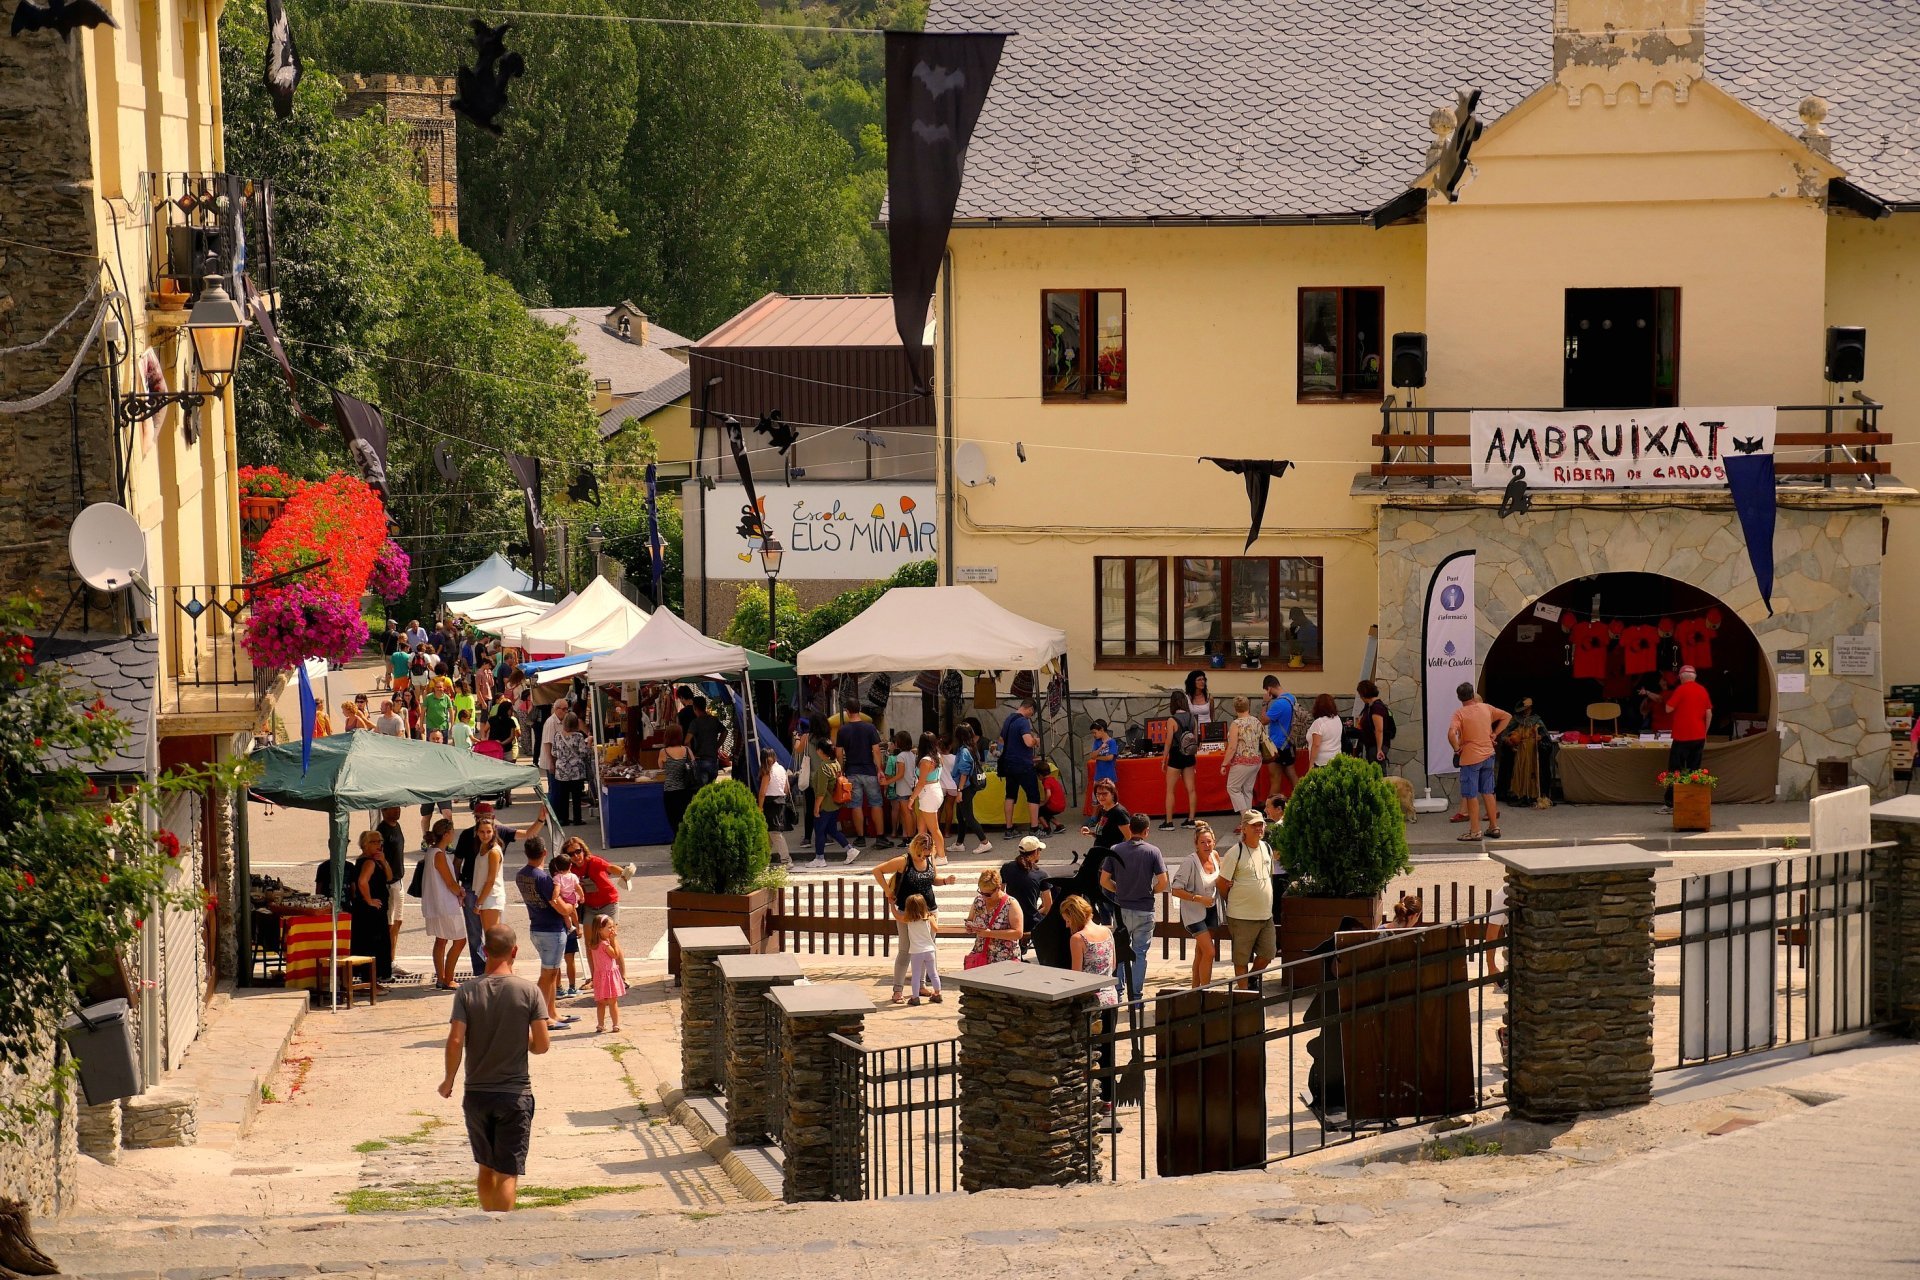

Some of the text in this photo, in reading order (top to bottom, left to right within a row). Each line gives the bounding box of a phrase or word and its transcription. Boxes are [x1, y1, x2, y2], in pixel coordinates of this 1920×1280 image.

[1627, 470, 1642, 480] DE
[793, 500, 854, 521] Escola
[791, 522, 841, 551] ELS
[1428, 657, 1443, 668] Vall
